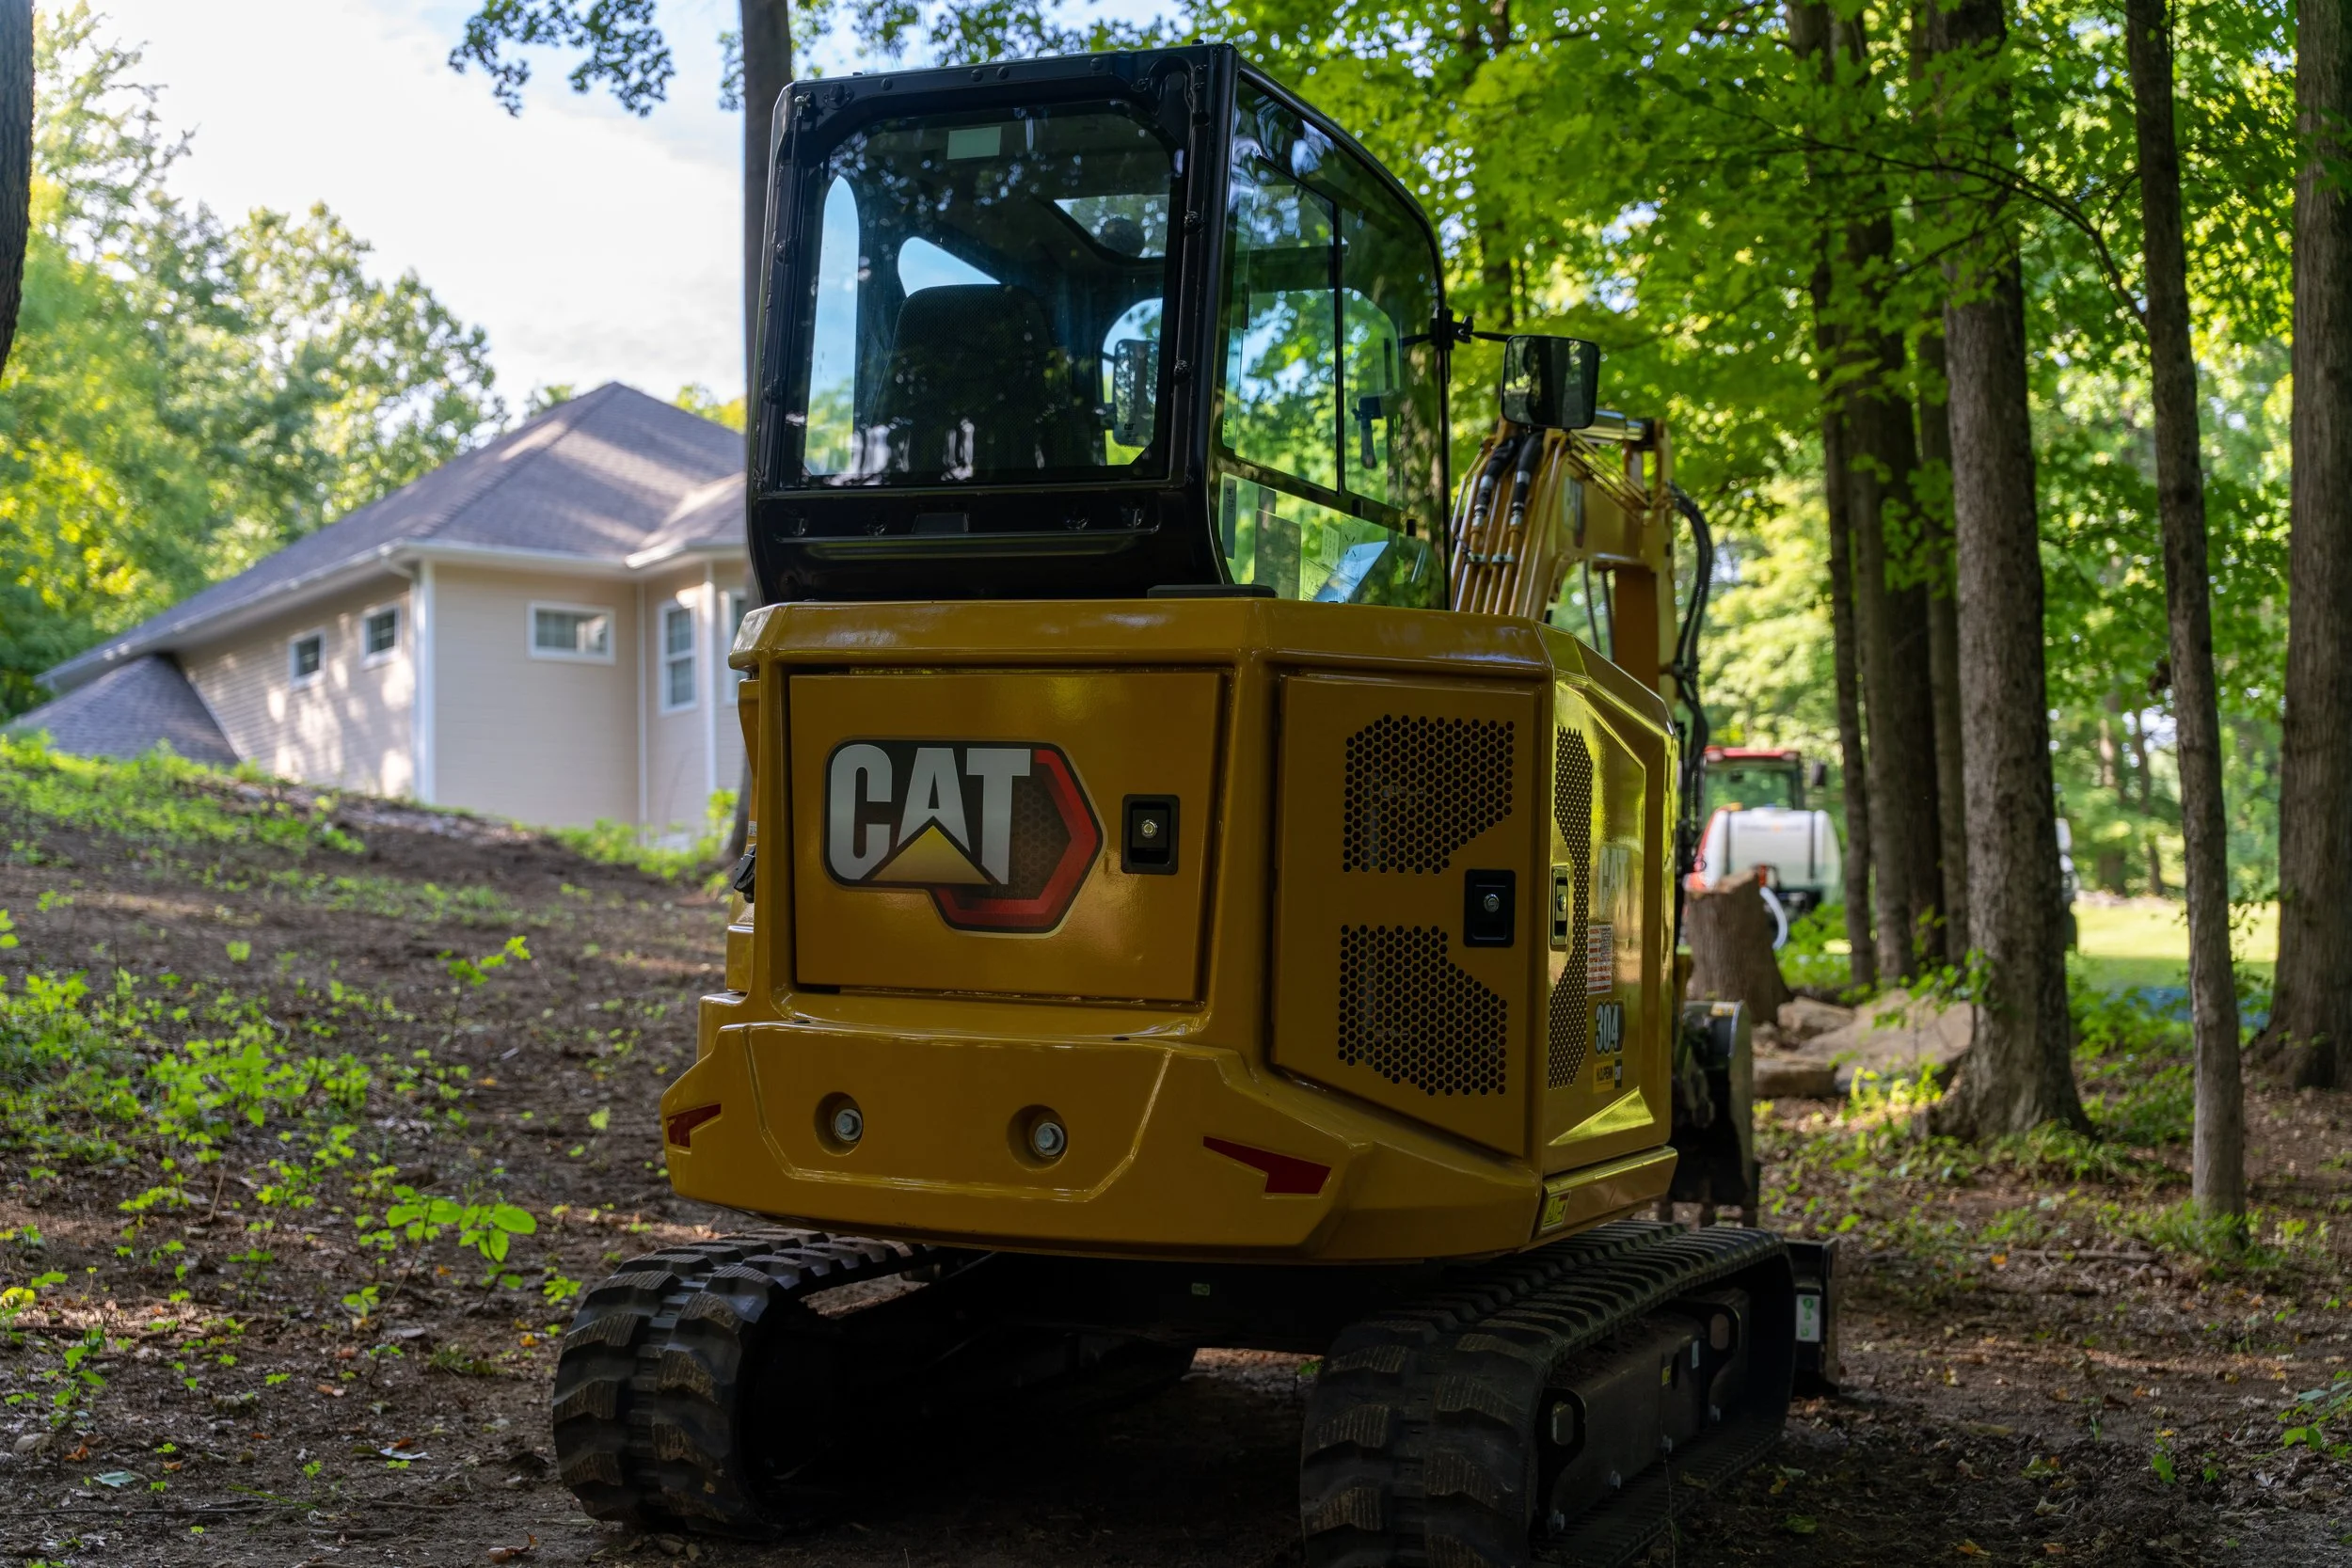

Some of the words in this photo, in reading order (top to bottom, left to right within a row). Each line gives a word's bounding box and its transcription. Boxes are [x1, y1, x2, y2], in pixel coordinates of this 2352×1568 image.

[829, 743, 1031, 885] CAT
[1597, 846, 1629, 918] CAT
[1596, 1004, 1619, 1052] 304
